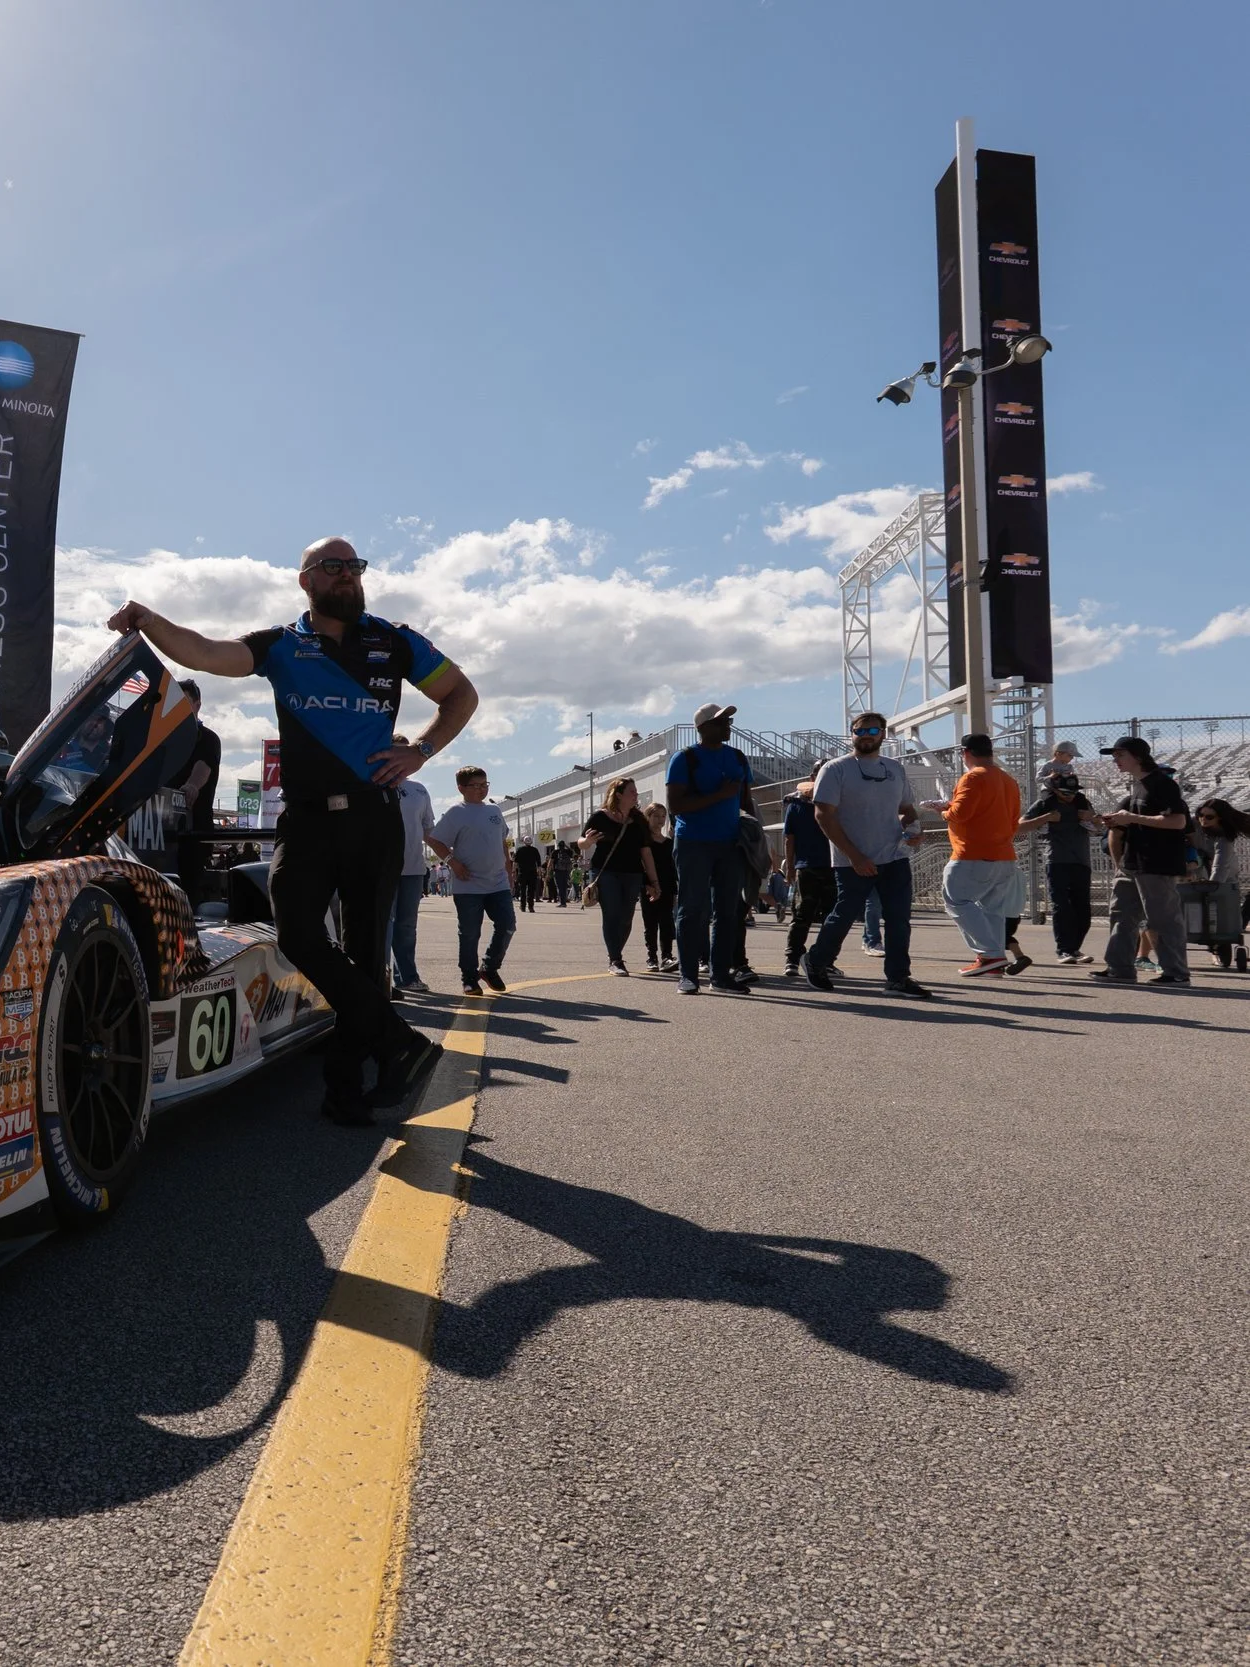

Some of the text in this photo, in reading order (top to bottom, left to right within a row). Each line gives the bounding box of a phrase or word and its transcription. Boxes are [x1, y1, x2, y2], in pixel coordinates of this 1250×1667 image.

[988, 256, 1030, 266] CHEVROLET
[991, 333, 1015, 341] CHEV
[1, 398, 55, 418] MINOLTA
[994, 416, 1036, 426] CHEVROLET
[997, 488, 1039, 498] CHEVROLET
[368, 677, 394, 688] HRC
[304, 695, 394, 714] ACURA
[127, 794, 166, 851] MAX
[540, 832, 551, 841] 27
[184, 976, 235, 995] WeatherTech
[9, 988, 33, 1000] ACURA
[5, 1003, 33, 1014] MSR
[188, 995, 231, 1071] 60
[46, 1015, 56, 1103] PILOT SPORT
[49, 1127, 94, 1206] MICHELIN
